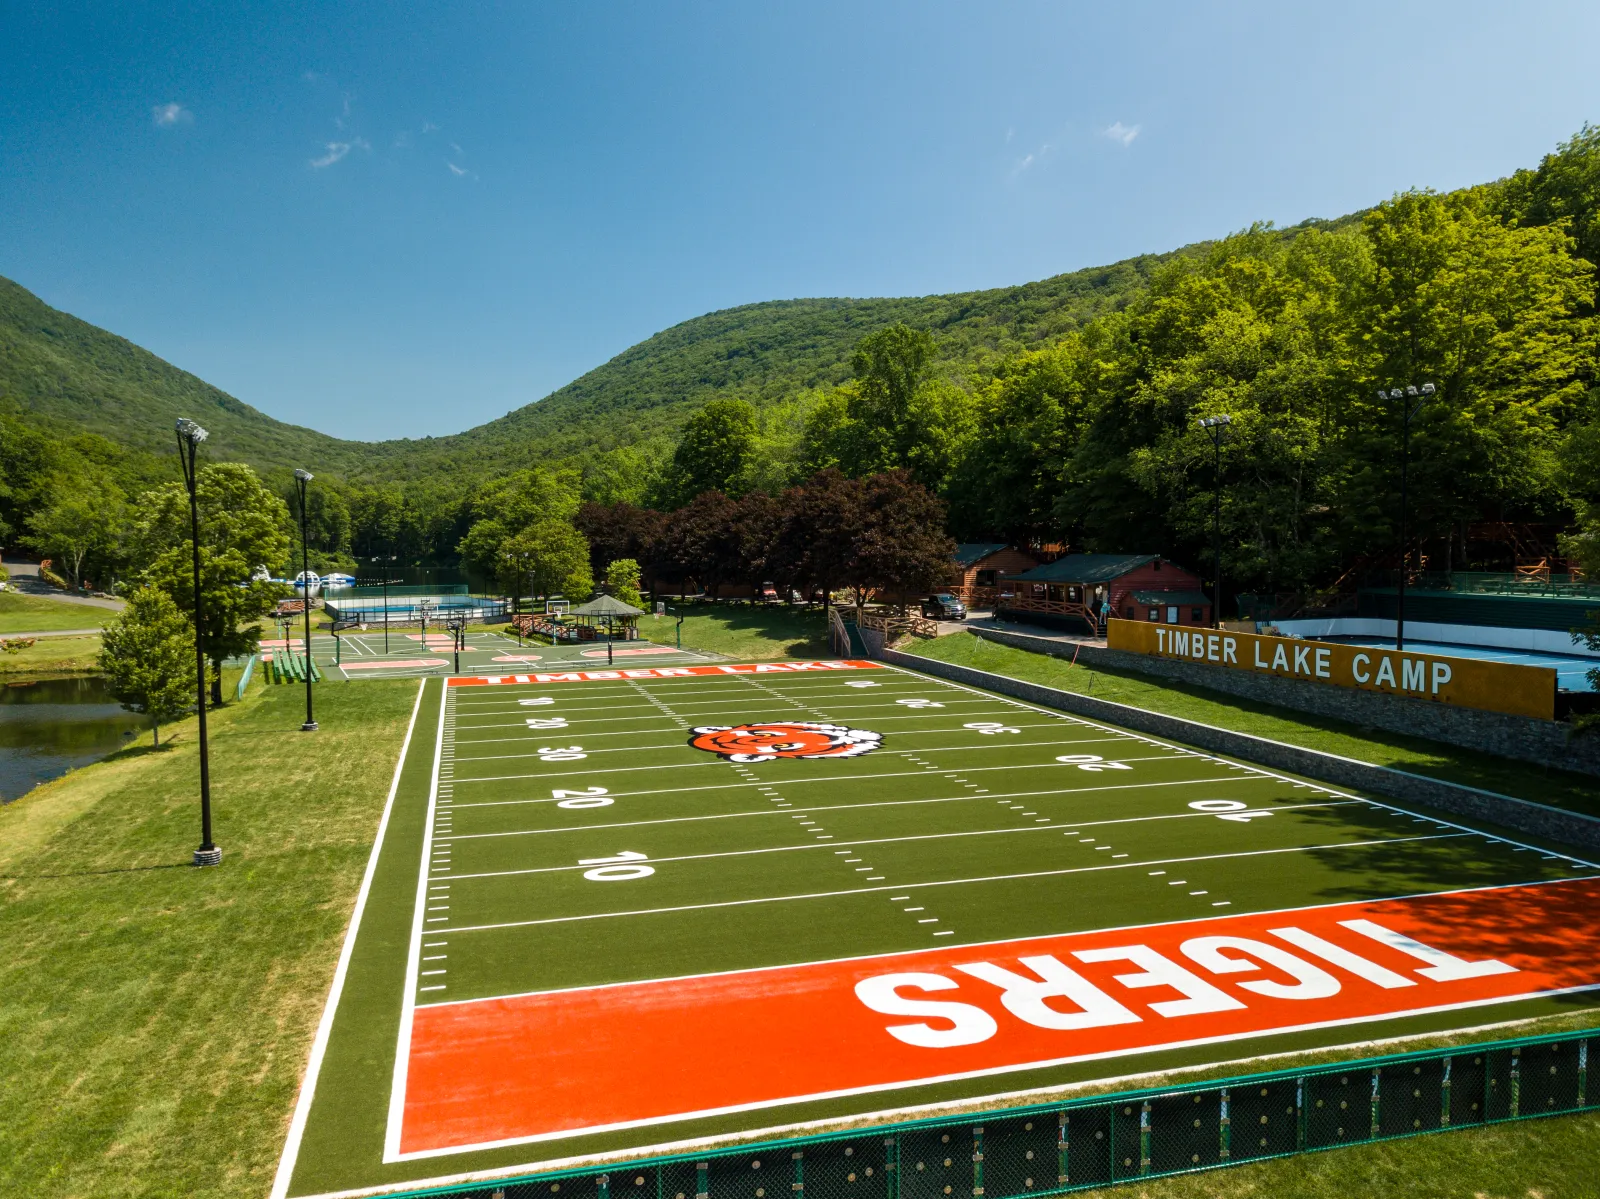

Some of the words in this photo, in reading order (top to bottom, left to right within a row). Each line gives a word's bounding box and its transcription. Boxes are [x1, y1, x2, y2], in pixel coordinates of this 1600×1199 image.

[478, 668, 697, 684] TIMBER
[717, 661, 857, 673] LAKE
[1156, 629, 1237, 664] TIMBER
[1255, 640, 1331, 678] LAKE
[1352, 653, 1452, 694] CAMP
[895, 699, 946, 709] 20
[526, 717, 569, 729] 20
[963, 722, 1021, 735] 30
[537, 746, 588, 761] 30
[1055, 755, 1133, 771] 20
[552, 787, 615, 809] 20
[1188, 800, 1274, 822] 10
[578, 851, 655, 881] 10
[854, 919, 1520, 1048] TIGERS
